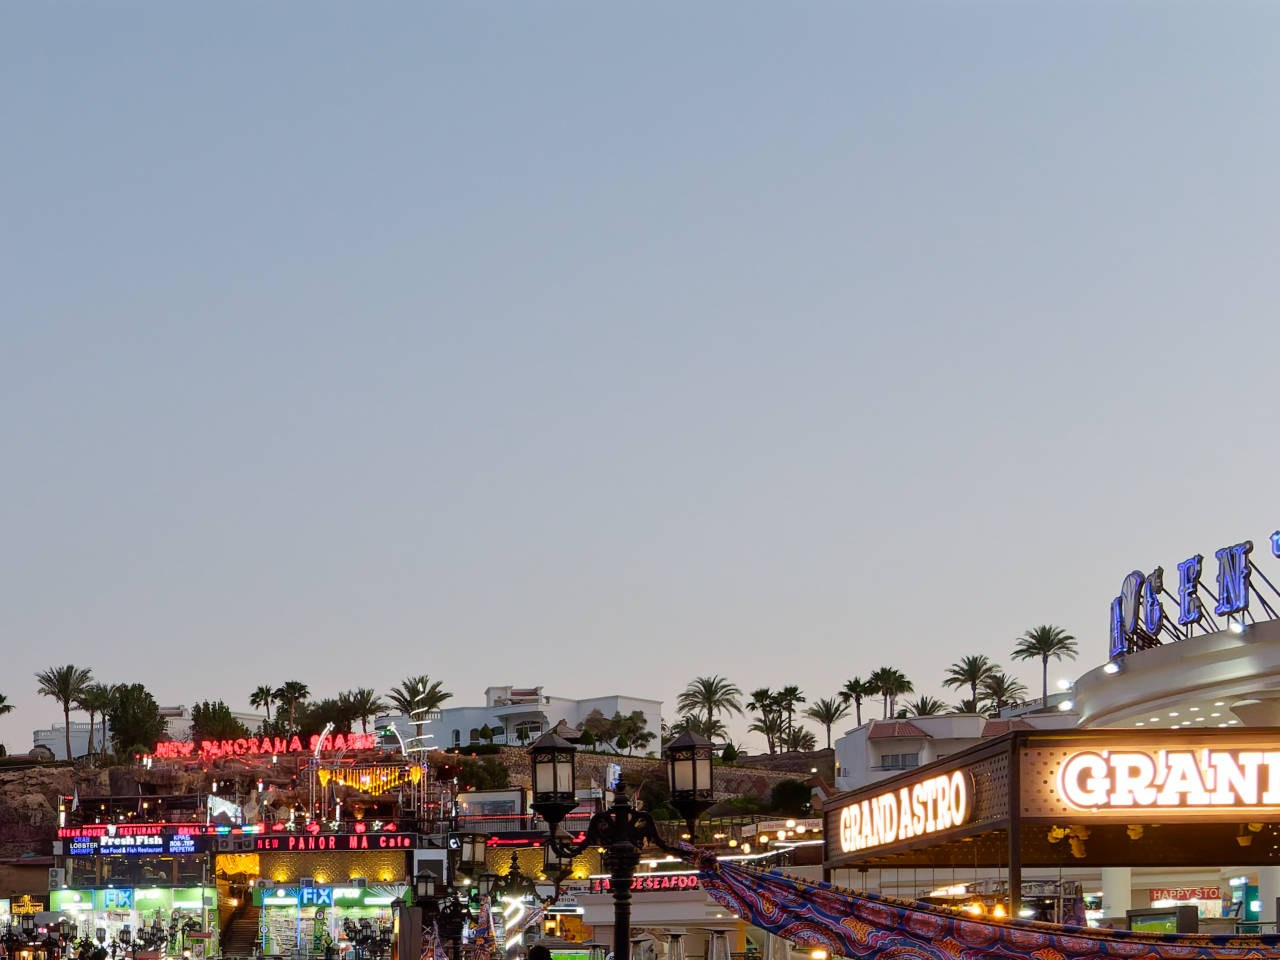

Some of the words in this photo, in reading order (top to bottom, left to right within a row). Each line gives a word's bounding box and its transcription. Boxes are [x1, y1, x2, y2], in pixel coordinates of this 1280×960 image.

[154, 741, 194, 757] NEW
[201, 735, 302, 757] PANORAMA
[310, 731, 374, 751] SHARM
[840, 793, 898, 853] GRAND
[898, 770, 966, 840] ASTRO
[58, 829, 81, 838] STEAK
[82, 828, 106, 837] HOUSE
[100, 835, 135, 846] Fresh
[135, 835, 163, 845] Fish
[257, 839, 279, 849] NEW
[379, 835, 412, 848] Cafe
[1153, 890, 1191, 900] HAPPY
